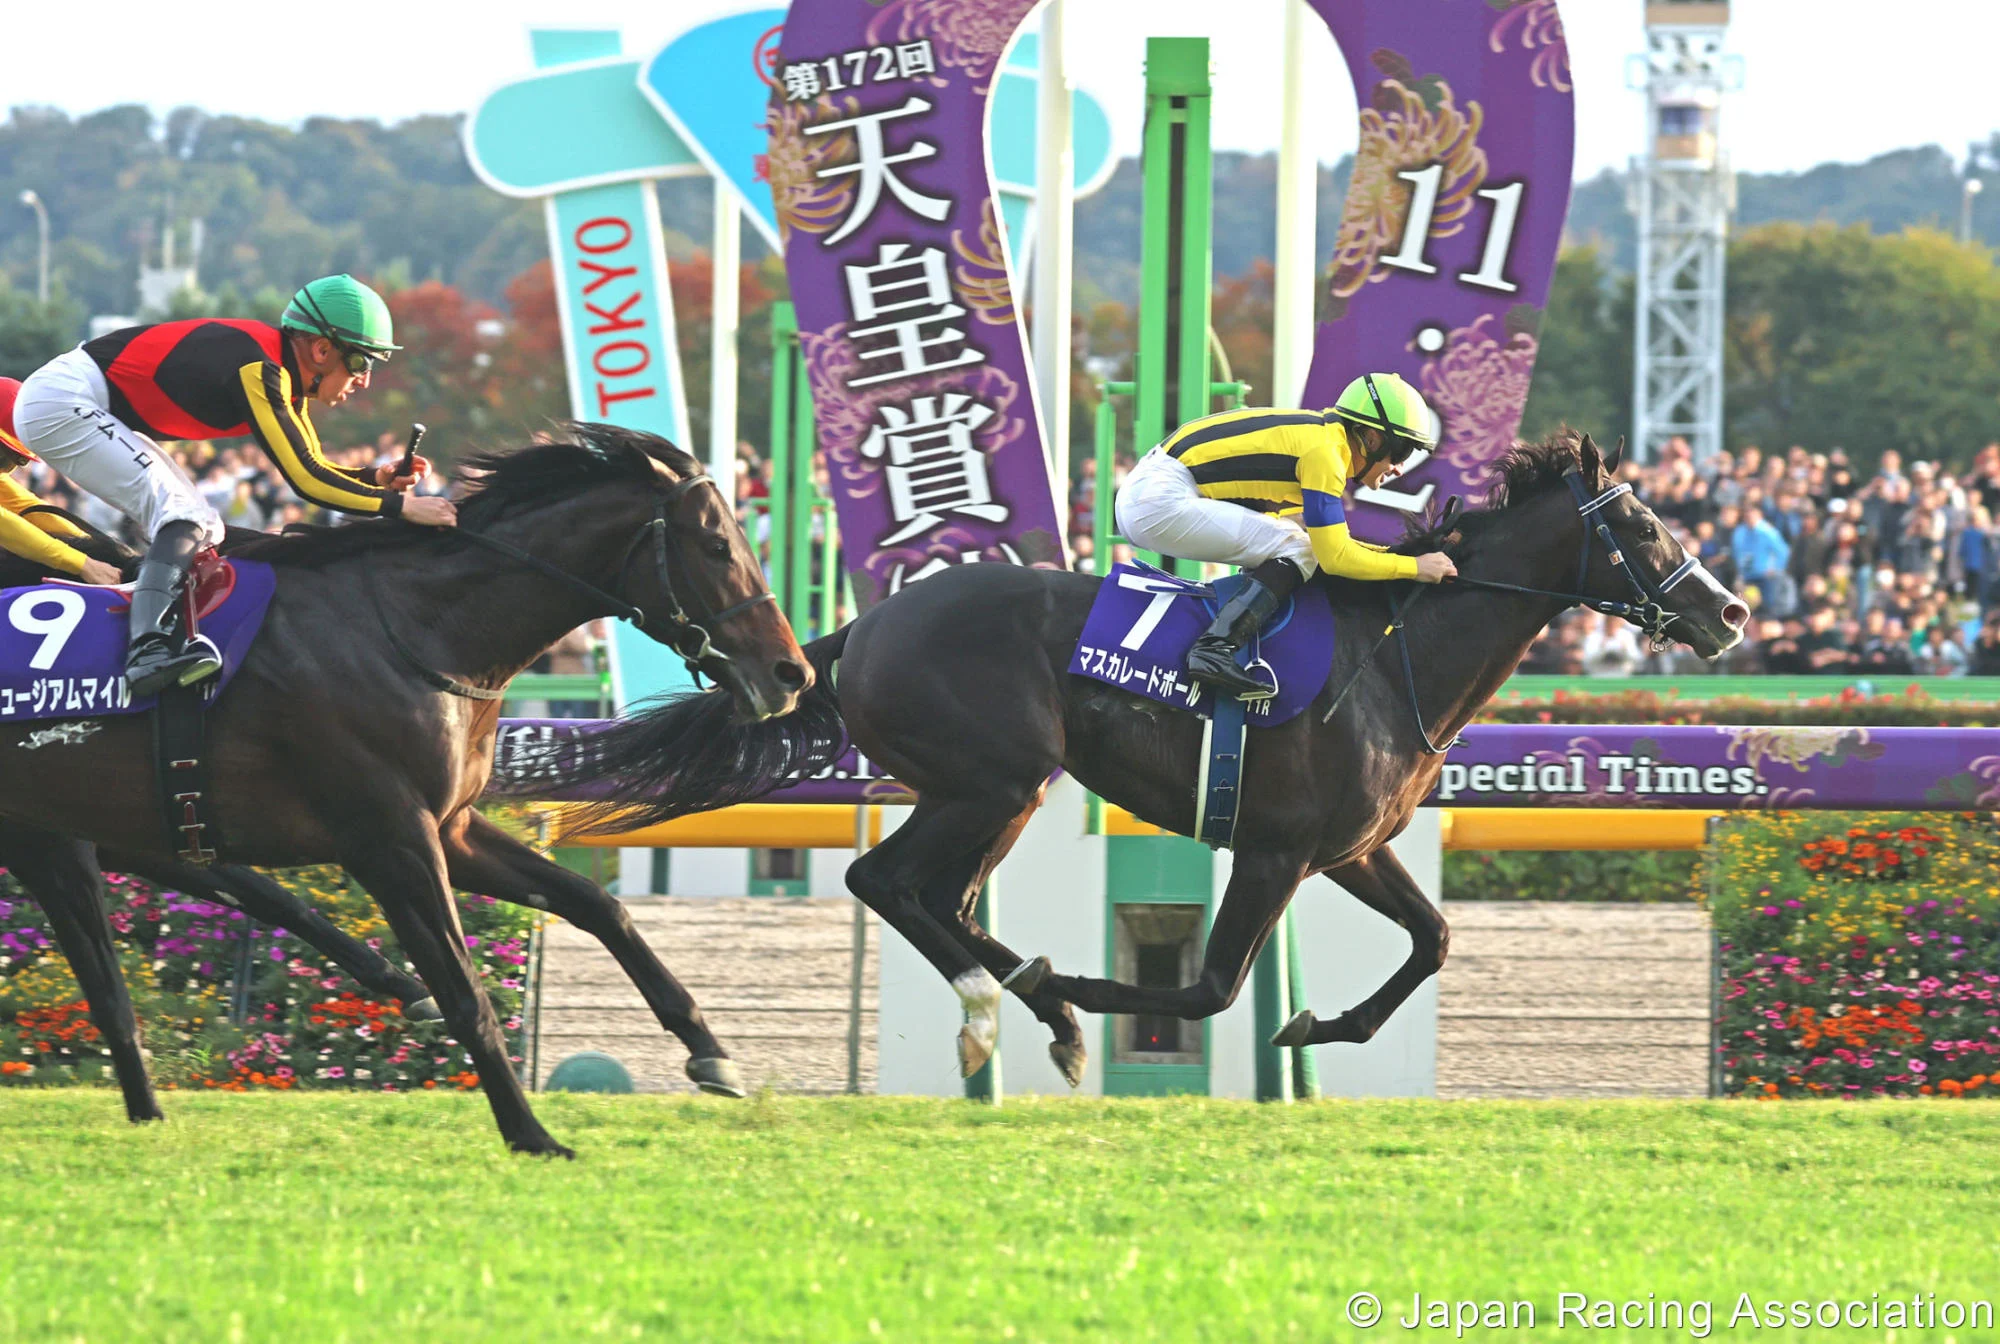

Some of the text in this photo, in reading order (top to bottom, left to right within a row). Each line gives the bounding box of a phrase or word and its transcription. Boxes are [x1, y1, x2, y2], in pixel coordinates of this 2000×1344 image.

[782, 40, 935, 102] 第172回
[574, 217, 657, 418] TOKYO
[8, 588, 87, 670] 9
[1117, 573, 1185, 651] 7
[1080, 645, 1200, 707] マスカレードボール
[1432, 756, 1768, 800] pecial Times.
